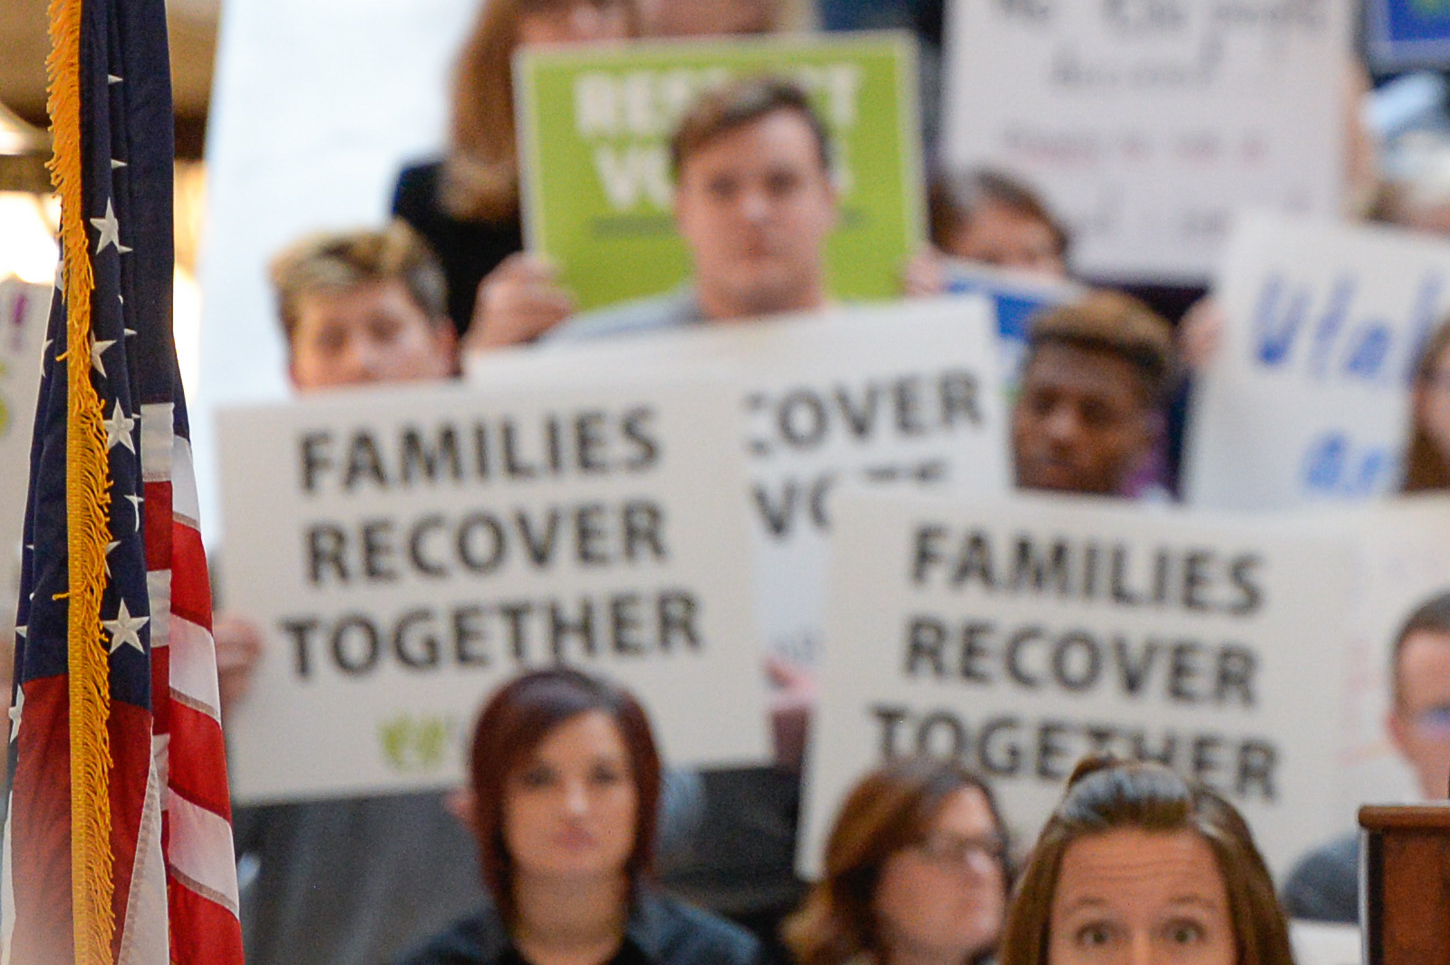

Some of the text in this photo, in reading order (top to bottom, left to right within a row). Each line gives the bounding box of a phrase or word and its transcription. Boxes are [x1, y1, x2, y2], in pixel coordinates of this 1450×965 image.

[301, 407, 658, 495] FAMILIES
[307, 499, 667, 586] RECOVER
[912, 526, 1265, 617] FAMILIES
[279, 589, 703, 679] TOGETHER
[904, 617, 1257, 707] RECOVER
